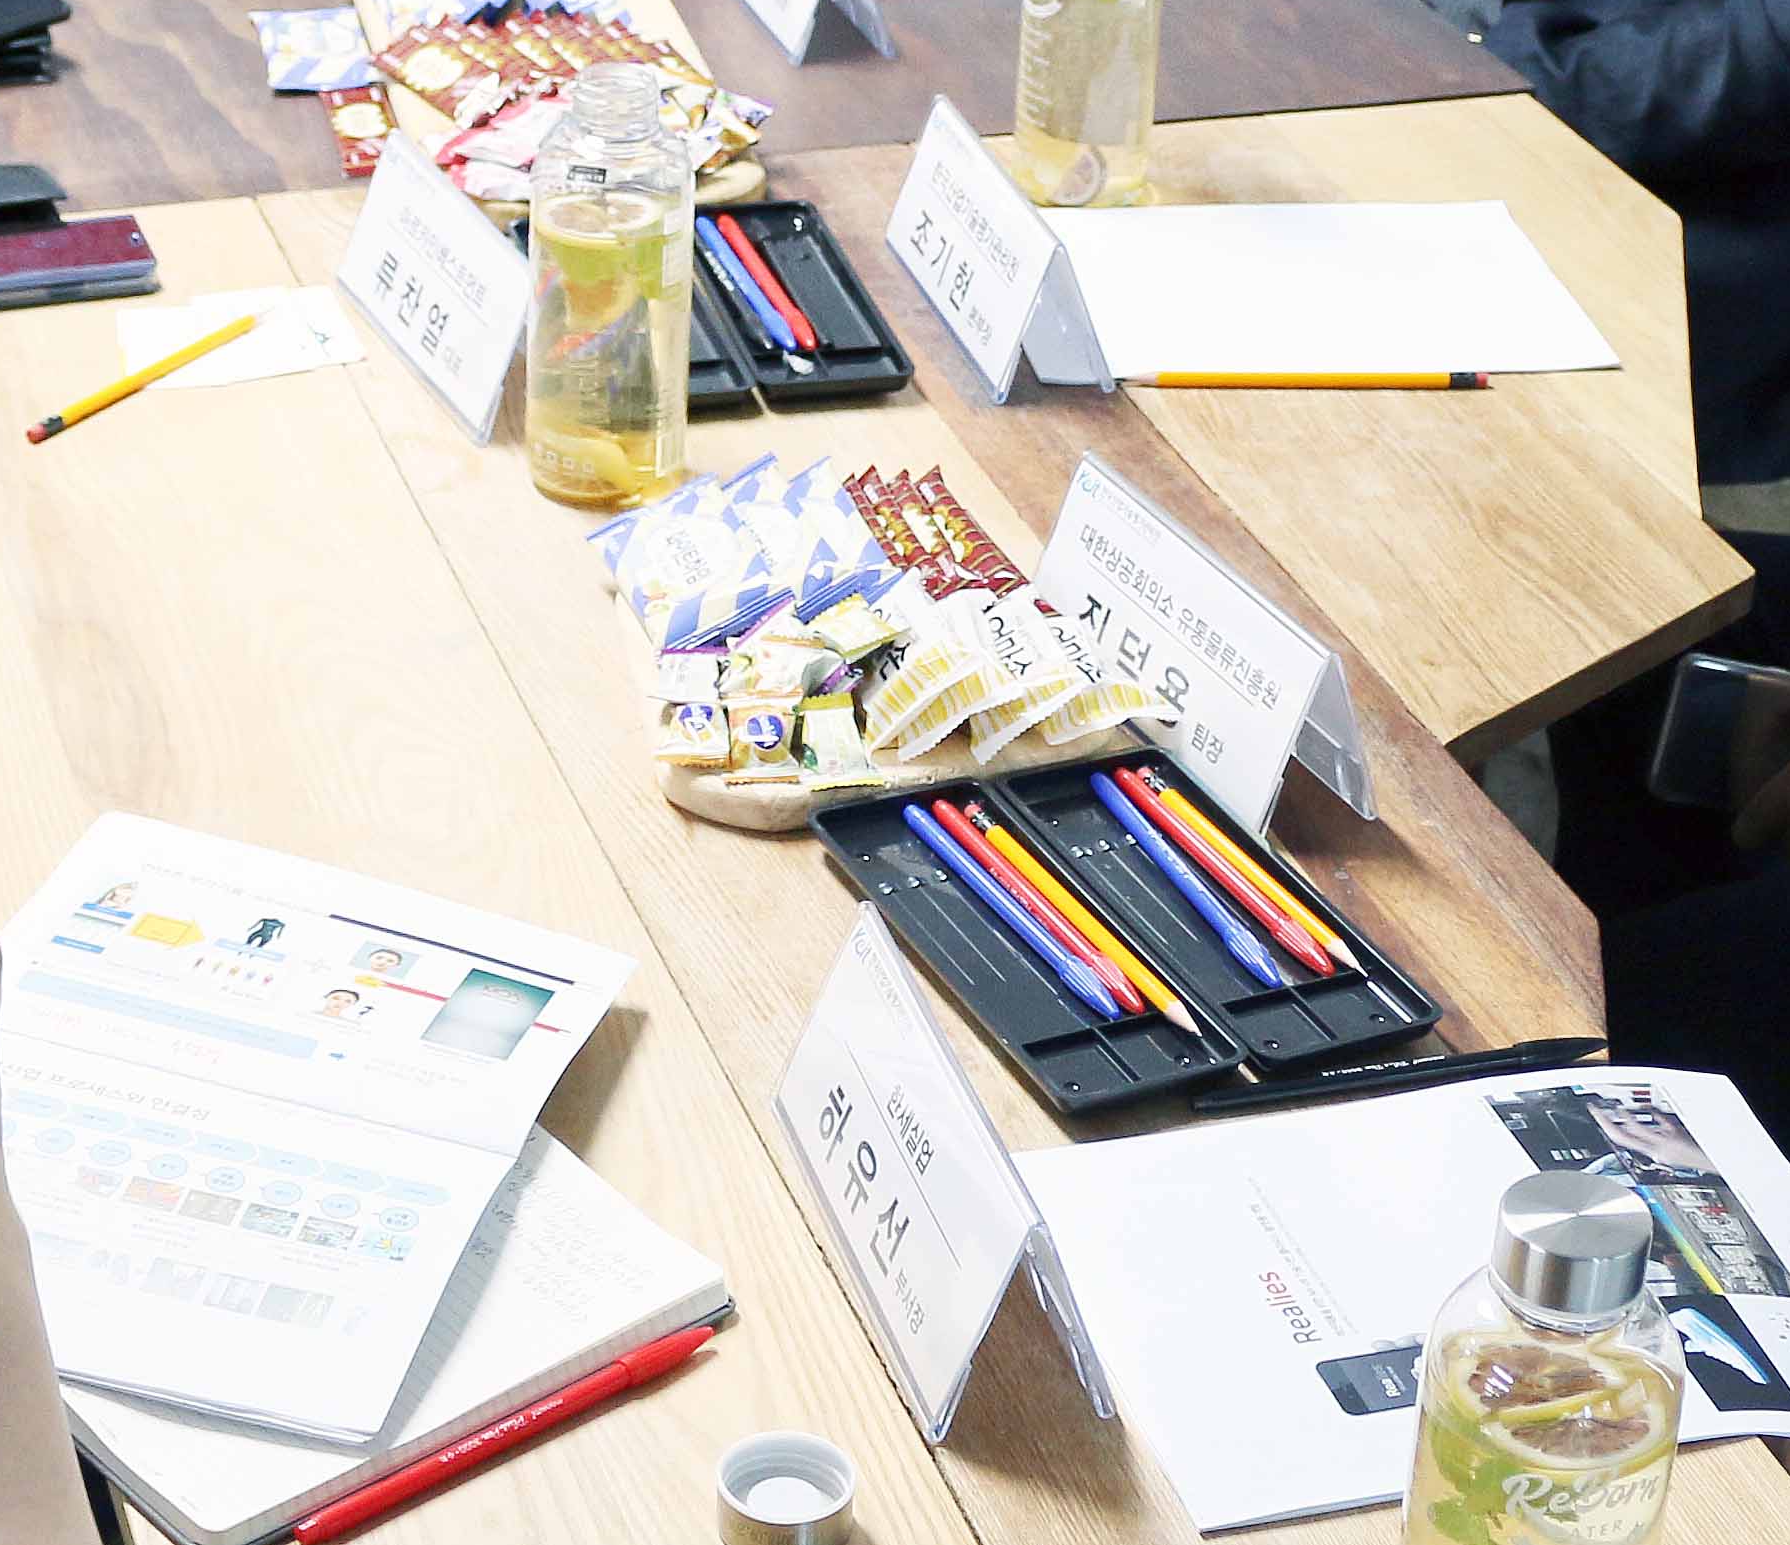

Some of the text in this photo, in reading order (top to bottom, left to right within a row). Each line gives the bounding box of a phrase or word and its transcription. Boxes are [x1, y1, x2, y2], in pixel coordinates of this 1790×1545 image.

[1080, 524, 1282, 711] 대한상공회의소 유통물류진흥원
[1191, 722, 1224, 765] 팀장
[885, 1083, 935, 1177] 한세실업
[819, 1084, 911, 1279] 하유선
[893, 1268, 926, 1336] 부서장
[1258, 1270, 1323, 1345] Realies
